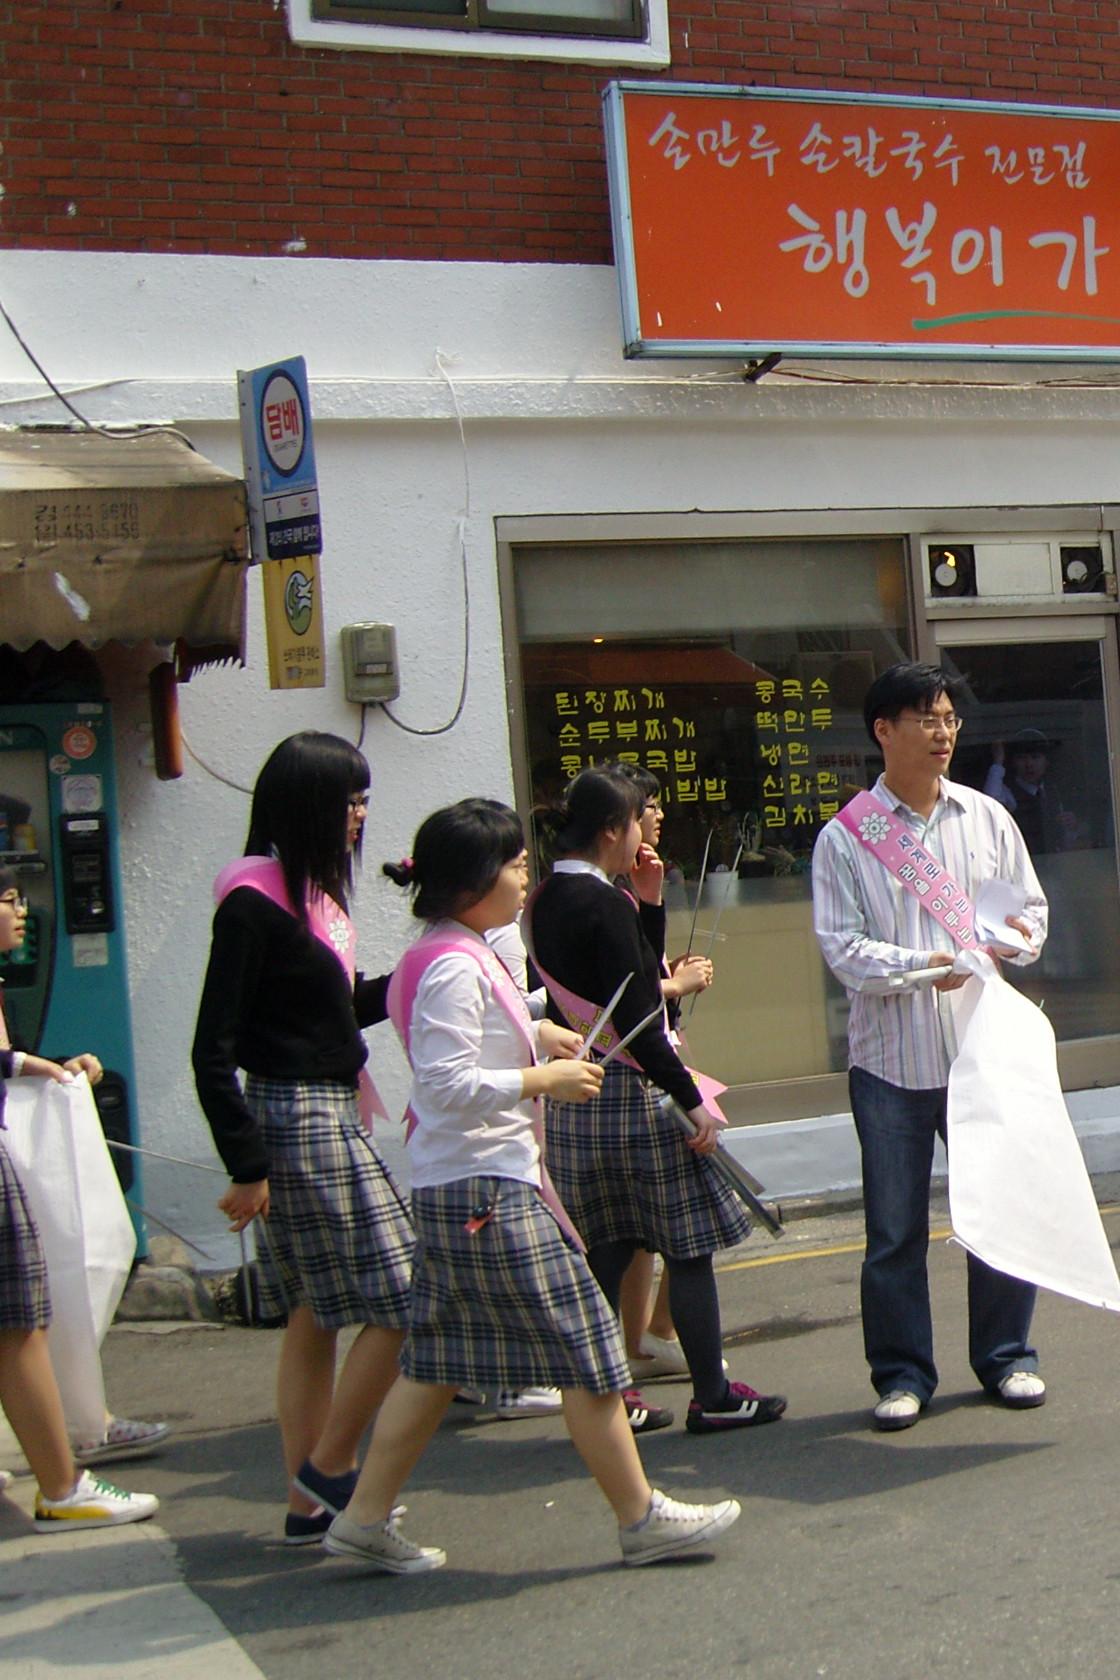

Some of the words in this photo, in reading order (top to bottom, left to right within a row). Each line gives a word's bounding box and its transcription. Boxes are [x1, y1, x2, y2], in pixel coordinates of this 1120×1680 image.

[649, 112, 780, 177] 손만두
[800, 122, 965, 187] 손칼국수
[985, 141, 1091, 189] 전문점
[779, 200, 1004, 306] 행복이
[555, 687, 665, 715] 된장찌개
[755, 677, 830, 703] 콩국수
[559, 717, 696, 747] 순두부찌개
[756, 708, 833, 733] 떡만두
[560, 749, 697, 779] 콩국밥
[760, 742, 809, 766] 냉면
[763, 771, 838, 798] 신라면
[897, 834, 941, 880] 세계로
[940, 881, 970, 914] 가는
[898, 861, 932, 896] 꿈을
[930, 897, 974, 945] 이루는
